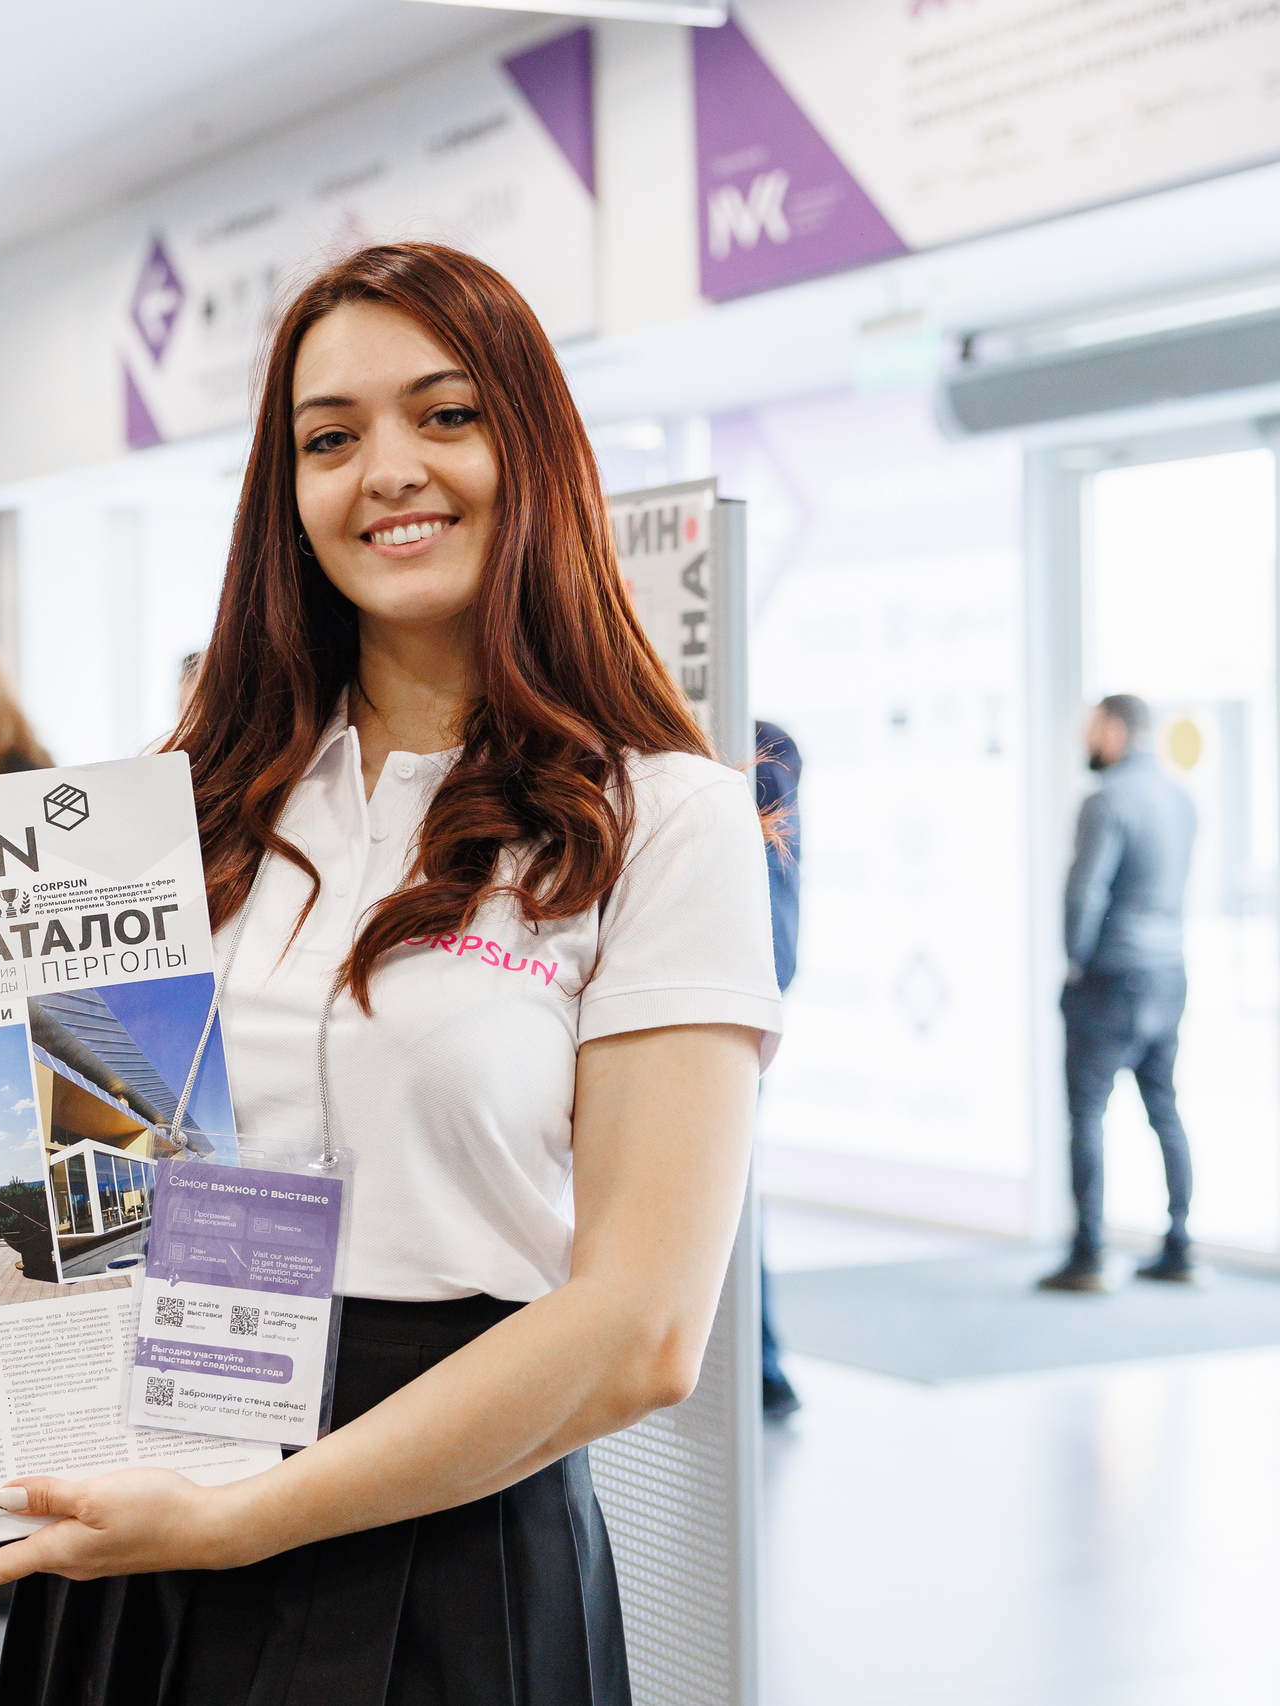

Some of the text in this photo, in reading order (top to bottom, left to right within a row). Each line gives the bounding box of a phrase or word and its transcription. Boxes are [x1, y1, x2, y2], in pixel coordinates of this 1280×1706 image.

[32, 878, 87, 893] CORPSUN
[94, 883, 143, 894] предприятие
[151, 877, 175, 888] сфере
[34, 895, 98, 908] промышленного
[46, 906, 73, 915] версии
[74, 902, 104, 911] премии
[105, 896, 137, 906] Золотой
[139, 893, 176, 903] меркурий
[42, 945, 187, 984] ПЕРГОЛЫ
[403, 931, 558, 986] RPSUN
[168, 1174, 329, 1204] Самое важное о выставке
[193, 1209, 231, 1221] Программа
[193, 1215, 237, 1228] мероприятий
[273, 1223, 302, 1233] Новости
[189, 1246, 206, 1255] План
[251, 1249, 313, 1264] Visit our website
[250, 1264, 314, 1279] information about
[260, 1259, 274, 1268] get
[275, 1260, 288, 1268] the
[288, 1262, 321, 1273] essential
[249, 1272, 299, 1285] the exhibition
[197, 1300, 220, 1309] сайте
[186, 1309, 223, 1319] выставки
[270, 1310, 317, 1322] приложении
[184, 1323, 206, 1331] website
[262, 1317, 297, 1330] LeadFrog
[151, 1344, 244, 1364] Выгодно участвуйте
[157, 1355, 201, 1366] выставке
[201, 1360, 261, 1375] следующего
[262, 1368, 284, 1377] года
[178, 1387, 306, 1411] Забронируйте стенд сейчас!
[177, 1400, 304, 1424] Book your stand for the next year
